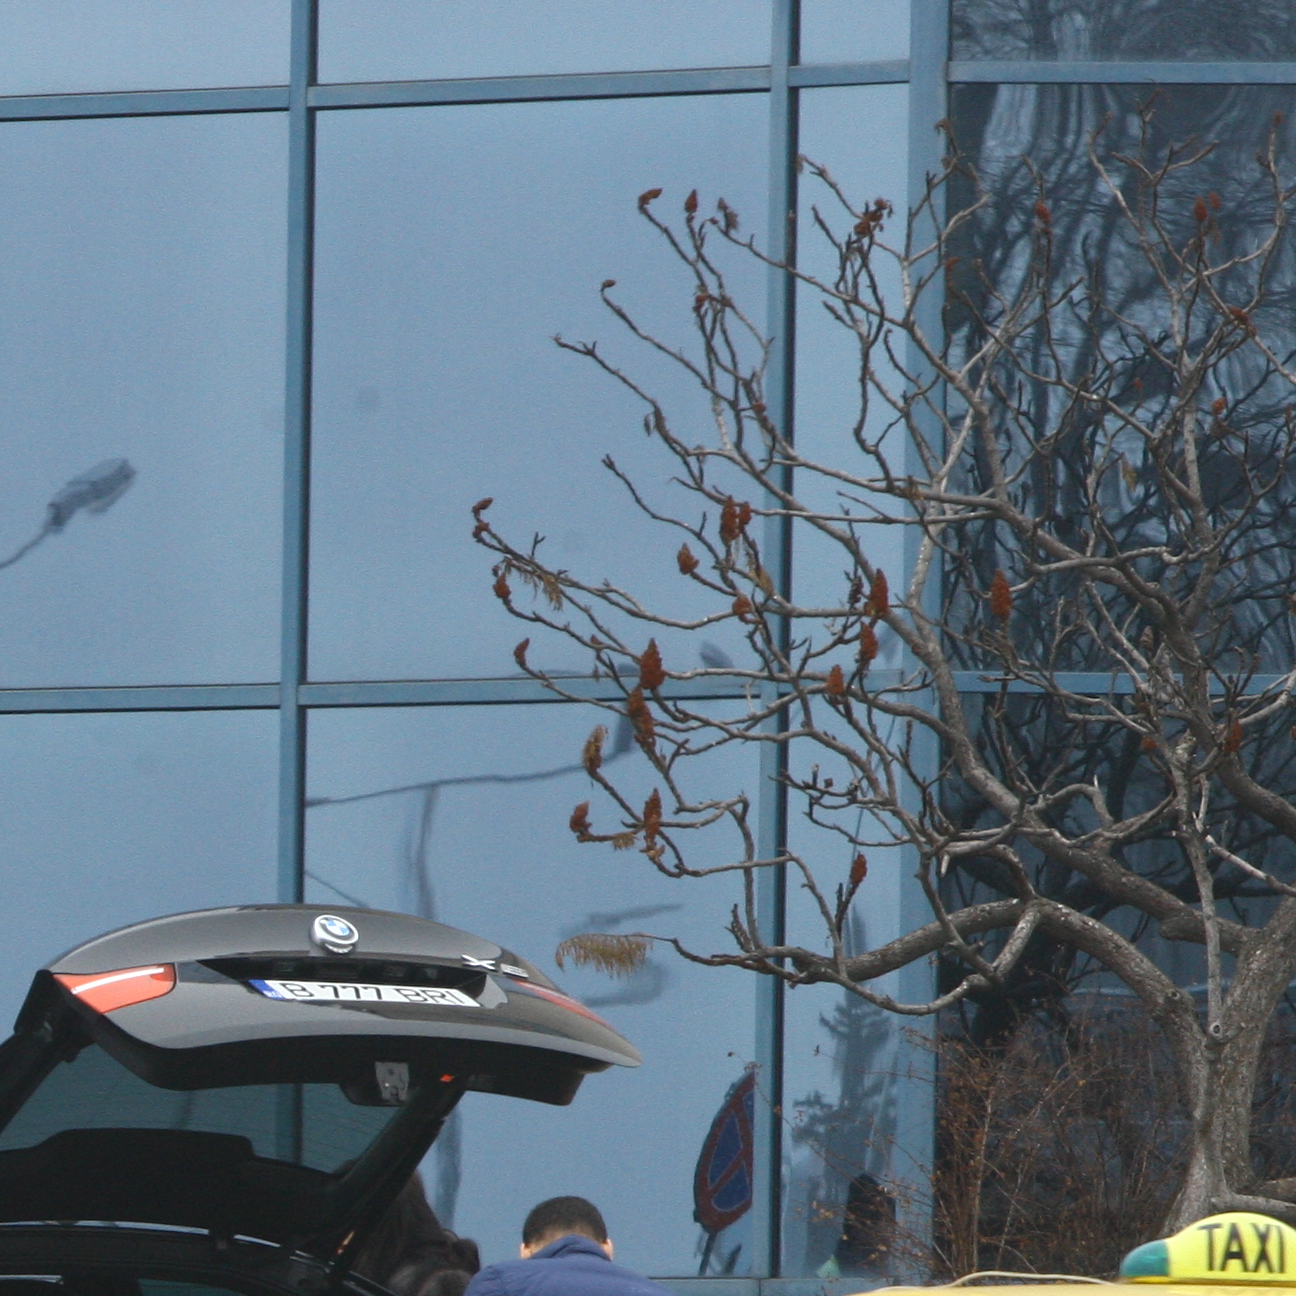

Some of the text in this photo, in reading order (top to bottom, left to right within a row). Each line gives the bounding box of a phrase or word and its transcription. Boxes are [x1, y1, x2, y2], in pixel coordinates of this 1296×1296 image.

[279, 983, 314, 997] B
[317, 984, 382, 1000] 777
[1197, 1222, 1285, 1273] TAXI
